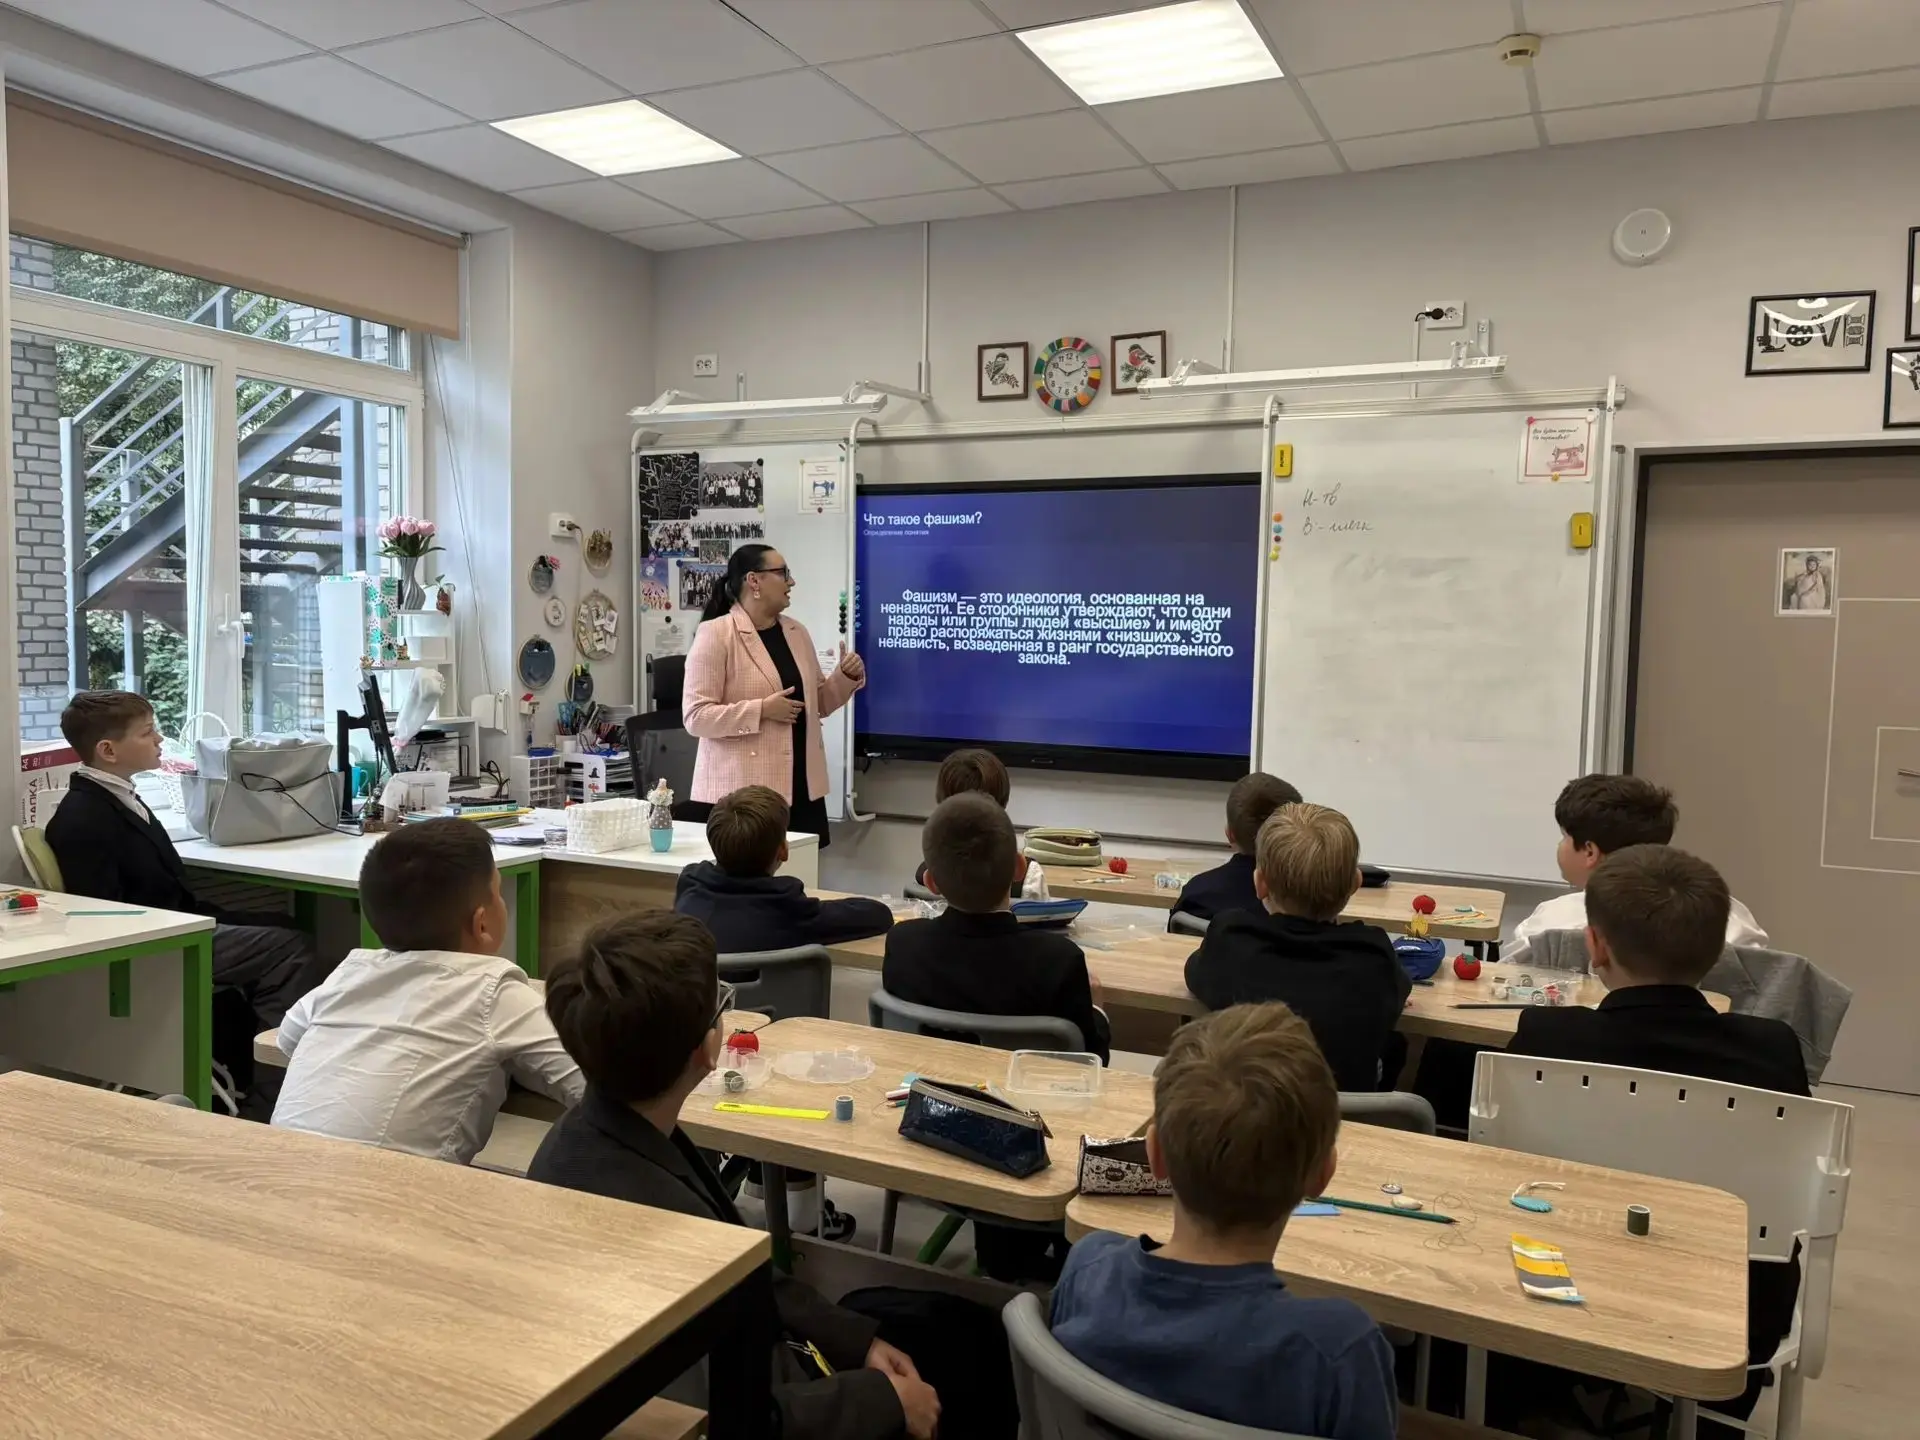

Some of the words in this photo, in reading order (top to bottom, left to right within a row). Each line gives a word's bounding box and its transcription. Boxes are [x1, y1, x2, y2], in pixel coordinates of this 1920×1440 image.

[864, 513, 884, 525] Что
[887, 515, 920, 525] такое
[923, 511, 982, 527] фашизм?
[902, 589, 957, 603] Фашизм
[980, 592, 1003, 603] это
[1007, 593, 1085, 606] идеология,
[1090, 593, 1180, 605] основанная
[1186, 593, 1204, 605] на
[881, 603, 952, 615] ненависти.
[957, 602, 975, 615] Ее
[978, 604, 1058, 617] сторонники
[1063, 605, 1156, 619] утверждают,
[1161, 606, 1187, 618] что
[1191, 607, 1231, 620] одни
[888, 614, 937, 628] народы
[942, 616, 967, 627] или
[971, 616, 1018, 630] группы
[1022, 617, 1069, 630] людей
[1073, 618, 1151, 630] «высшие»
[1155, 620, 1165, 630] и
[1169, 620, 1222, 631] имеют
[888, 627, 927, 639] право
[930, 627, 1034, 642] распоряжаться
[1037, 630, 1101, 642] жизнями
[1106, 631, 1186, 643] «низших».
[1190, 630, 1221, 644] Это
[879, 638, 950, 651] ненависть,
[954, 640, 1043, 653] возведенная
[1047, 643, 1056, 653] в
[1059, 642, 1091, 657] ранг
[1096, 643, 1234, 658] государственного
[1018, 654, 1071, 665] закона.
[29, 778, 38, 823] ПАПКА
